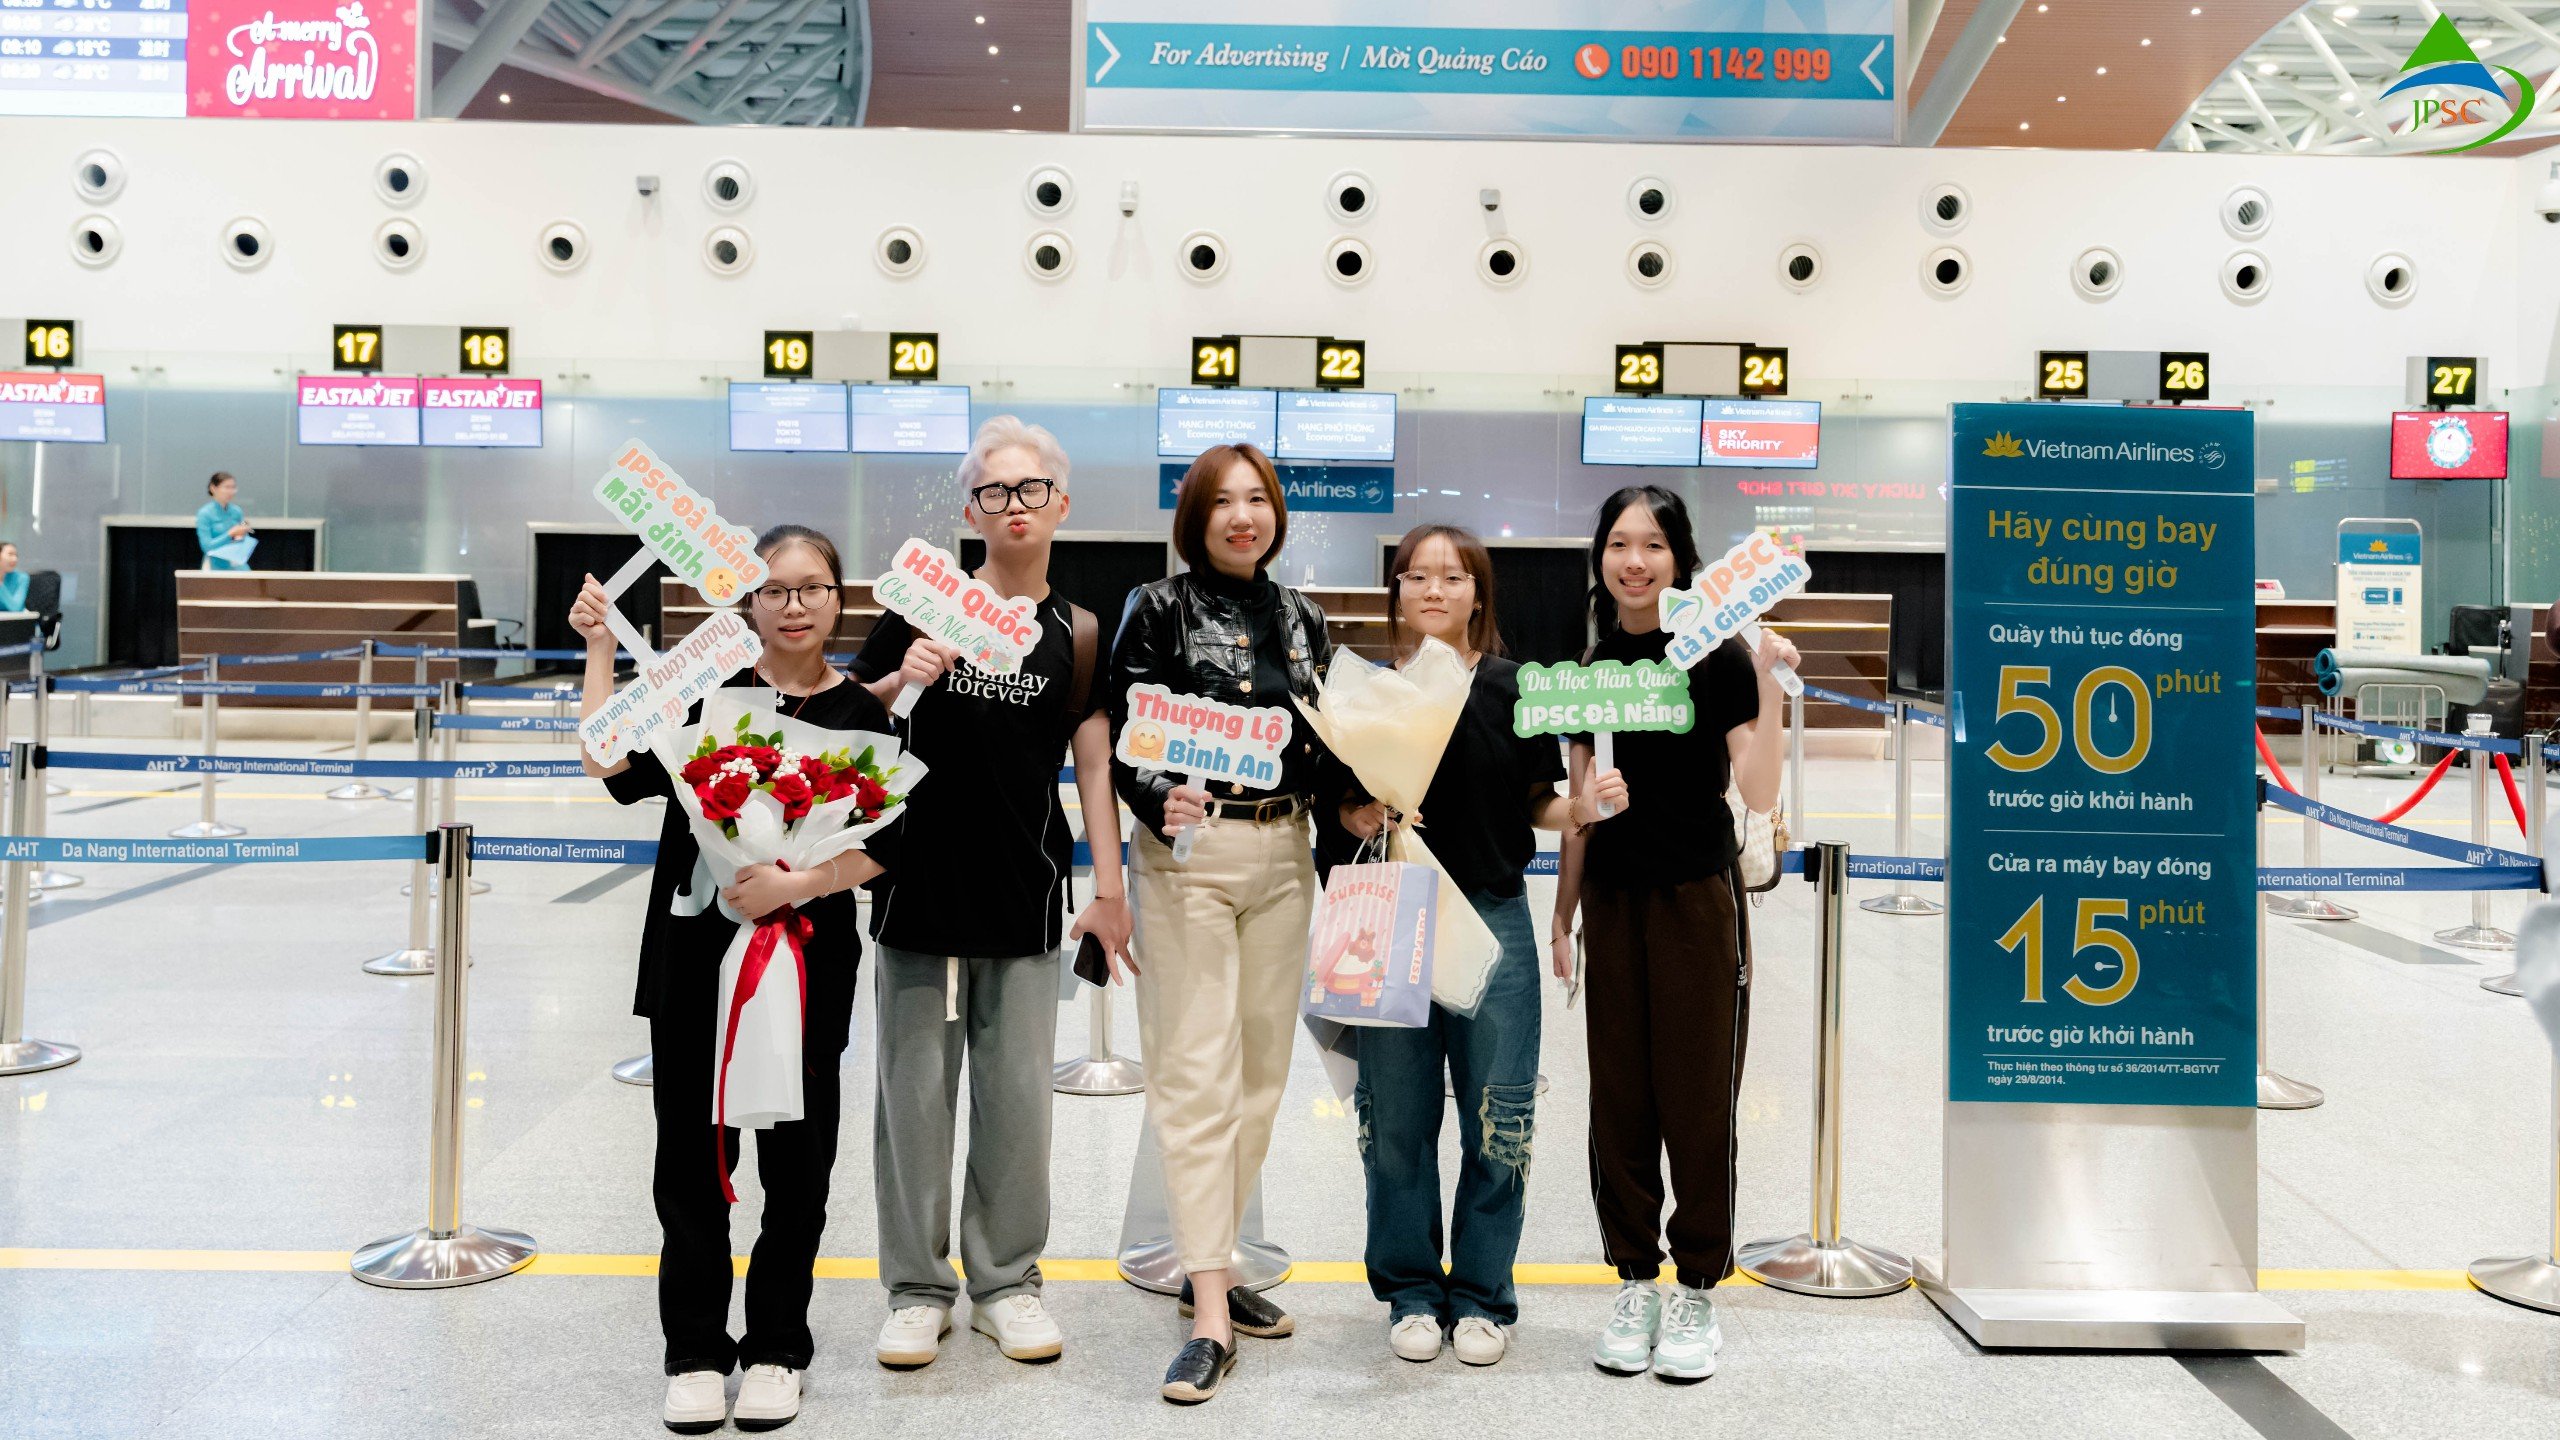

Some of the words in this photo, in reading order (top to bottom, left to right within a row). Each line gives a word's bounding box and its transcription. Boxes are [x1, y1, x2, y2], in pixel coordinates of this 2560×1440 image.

[278, 20, 342, 51] merry
[226, 32, 378, 105] Arrival
[1150, 41, 1191, 66] For
[1195, 42, 1329, 73] Advertising
[1360, 45, 1411, 70] Mời
[1418, 47, 1496, 75] Quảng
[1501, 47, 1548, 72] Cáo
[1621, 45, 1680, 79] 090
[1689, 46, 1765, 81] 1142
[1773, 48, 1832, 82] 999
[29, 326, 70, 358] 16
[337, 332, 378, 363] 17
[464, 334, 504, 366] 18
[769, 339, 808, 370] 19
[894, 341, 935, 371] 20
[1198, 346, 1235, 376] 21
[1321, 348, 1361, 378] 22
[1620, 354, 1659, 384] 23
[1744, 357, 1783, 386] 24
[2044, 360, 2084, 389] 25
[2165, 361, 2205, 390] 26
[0, 383, 60, 402] ASTAR
[65, 385, 100, 404] JET
[2433, 366, 2472, 395] 27
[302, 387, 376, 406] EASTAR
[379, 388, 415, 407] JET
[425, 389, 500, 408] EASTAR
[502, 390, 538, 408] JET
[1187, 430, 1224, 441] Economy
[1226, 430, 1247, 440] Class
[1305, 432, 1343, 443] Economy
[1345, 433, 1366, 443] Class
[1718, 428, 1747, 440] SKY
[1718, 439, 1783, 450] PRIORITY
[2025, 439, 2113, 460] Vietnam
[2115, 442, 2195, 463] Airlines
[602, 477, 653, 524] Mãi
[1286, 480, 1357, 498] Airlines
[672, 494, 709, 532] Đà
[1987, 510, 2052, 547] Hãy
[2061, 512, 2147, 550] cùng
[2157, 514, 2218, 552] bay
[1700, 538, 1775, 608] JPSC
[2027, 555, 2115, 594] đúng
[2124, 558, 2178, 595] giờ
[902, 547, 960, 598] Hàn
[961, 588, 1033, 646] Quốc
[911, 596, 941, 625] Tôi
[1672, 635, 1703, 663] Là
[1698, 625, 1717, 644] 1
[1714, 601, 1753, 631] Gia
[1748, 562, 1803, 606] Đình
[684, 614, 740, 662] Thành
[1989, 623, 2044, 648] Quầy
[2050, 625, 2084, 645] thủ
[2089, 627, 2124, 649] tục
[2128, 627, 2183, 651] đóng
[646, 653, 687, 690] công
[1525, 670, 1553, 692] Du
[1556, 669, 1591, 694] Học
[1594, 667, 1634, 690] Hàn
[1636, 664, 1681, 691] Quốc
[386, 687, 430, 696] International
[532, 691, 553, 700] AHT
[628, 683, 649, 703] các
[679, 684, 696, 701] xa
[946, 668, 1033, 707] forever
[500, 720, 522, 728] AHT
[535, 720, 551, 729] Da
[1135, 691, 1245, 741] Thượng
[1251, 715, 1284, 751] Lộ
[1522, 704, 1580, 731] JPSC
[1582, 699, 1619, 726] Đà
[1624, 693, 1688, 726] Nẵng
[1984, 664, 2153, 775] 50
[2156, 669, 2221, 699] phút
[585, 715, 609, 743] nhé
[2424, 734, 2436, 745] Nang
[2435, 736, 2462, 746] International
[2462, 737, 2481, 748] Terminal
[146, 760, 178, 771] AHT
[199, 759, 213, 770] Da
[214, 760, 242, 773] Nang
[244, 760, 308, 772] International
[309, 762, 353, 773] Terminal
[454, 767, 485, 778] AHT
[507, 765, 522, 775] Da
[523, 765, 551, 777] Nang
[1166, 738, 1231, 774] Bình
[1235, 754, 1274, 782] An
[1987, 789, 2045, 808] trước
[2050, 789, 2084, 813] giờ
[2089, 790, 2135, 810] khởi
[2141, 791, 2193, 811] hành
[2305, 805, 2320, 820] AHT
[2329, 811, 2337, 822] Da
[2338, 814, 2351, 830] Nang
[2351, 818, 2385, 838] International
[2384, 827, 2409, 844] Terminal
[6, 842, 40, 858] AHT
[62, 843, 84, 858] Da
[87, 842, 128, 861] Nang
[132, 841, 230, 859] International
[232, 841, 300, 858] Terminal
[473, 840, 563, 857] International
[565, 843, 625, 860] Terminal
[2465, 849, 2486, 865] AHT
[2499, 853, 2509, 866] Da
[1988, 852, 2030, 872] Cửa
[2036, 858, 2058, 873] ra
[2063, 855, 2108, 878] máy
[2113, 855, 2152, 879] bay
[2157, 856, 2212, 881] đóng
[2257, 873, 2342, 886] nternational
[2344, 872, 2405, 886] Terminal
[1329, 881, 1395, 906] SURPRISE
[1994, 894, 2141, 1007] 15
[2139, 899, 2206, 930] phút
[1987, 1024, 2044, 1043] trước
[2050, 1025, 2084, 1048] giờ
[2089, 1025, 2135, 1045] khởi
[2141, 1026, 2194, 1046] hành
[1987, 1061, 2014, 1073] Thực
[2016, 1061, 2038, 1073] hiện
[2040, 1062, 2064, 1072] theo
[2065, 1062, 2095, 1074] thông
[2098, 1063, 2109, 1073] tư
[2110, 1062, 2123, 1073] số
[2125, 1063, 2220, 1074] 36/2014/TT-BGTVT
[1987, 1074, 2013, 1086] ngày
[2015, 1074, 2066, 1085] 29/8/2014.
